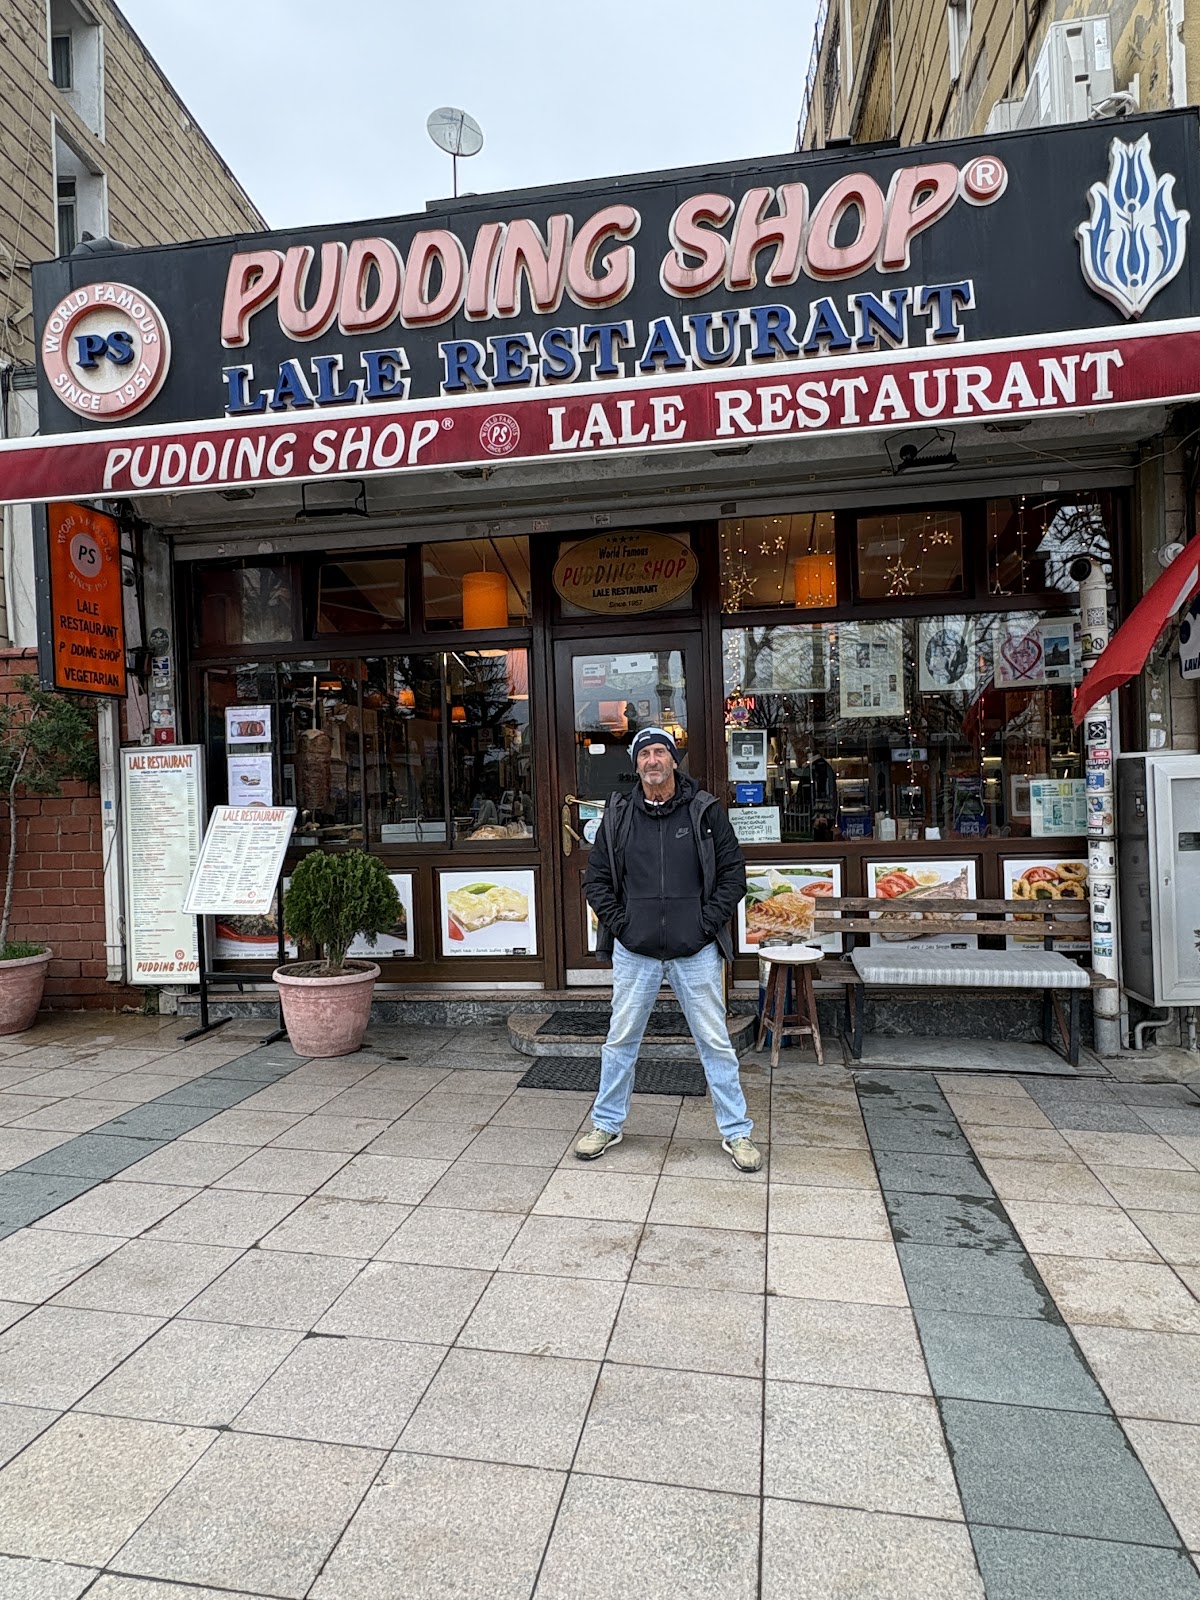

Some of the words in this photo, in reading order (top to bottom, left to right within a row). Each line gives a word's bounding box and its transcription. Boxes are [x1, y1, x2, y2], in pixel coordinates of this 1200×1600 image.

[222, 205, 641, 346] PUDDING
[45, 290, 88, 353] WORLD
[94, 285, 158, 345] FAMOUS
[75, 331, 135, 369] PS
[223, 349, 410, 417] LALE
[439, 281, 974, 392] RESTAURANT
[55, 373, 101, 410] SINCE
[116, 362, 152, 404] 1957
[548, 395, 687, 451] LALE
[715, 349, 1123, 436] RESTAURANT
[492, 426, 507, 443] PS
[103, 430, 295, 490] PUDDING
[78, 545, 96, 564] PS
[598, 546, 620, 559] World
[622, 545, 649, 558] Famous
[562, 562, 636, 587] PUDDING
[592, 588, 610, 597] LALE
[611, 584, 658, 596] RESTAURANT
[77, 599, 99, 616] LALE
[60, 615, 119, 638] RESTAURANT
[64, 667, 119, 686] VEGETARIAN
[161, 731, 167, 740] 6
[129, 755, 146, 770] LALE
[147, 754, 193, 769] RESTAURANT
[223, 810, 240, 821] LALE
[240, 810, 286, 822] RESTAURANT
[136, 962, 175, 972] PUDDING
[177, 961, 199, 972] SHOP
